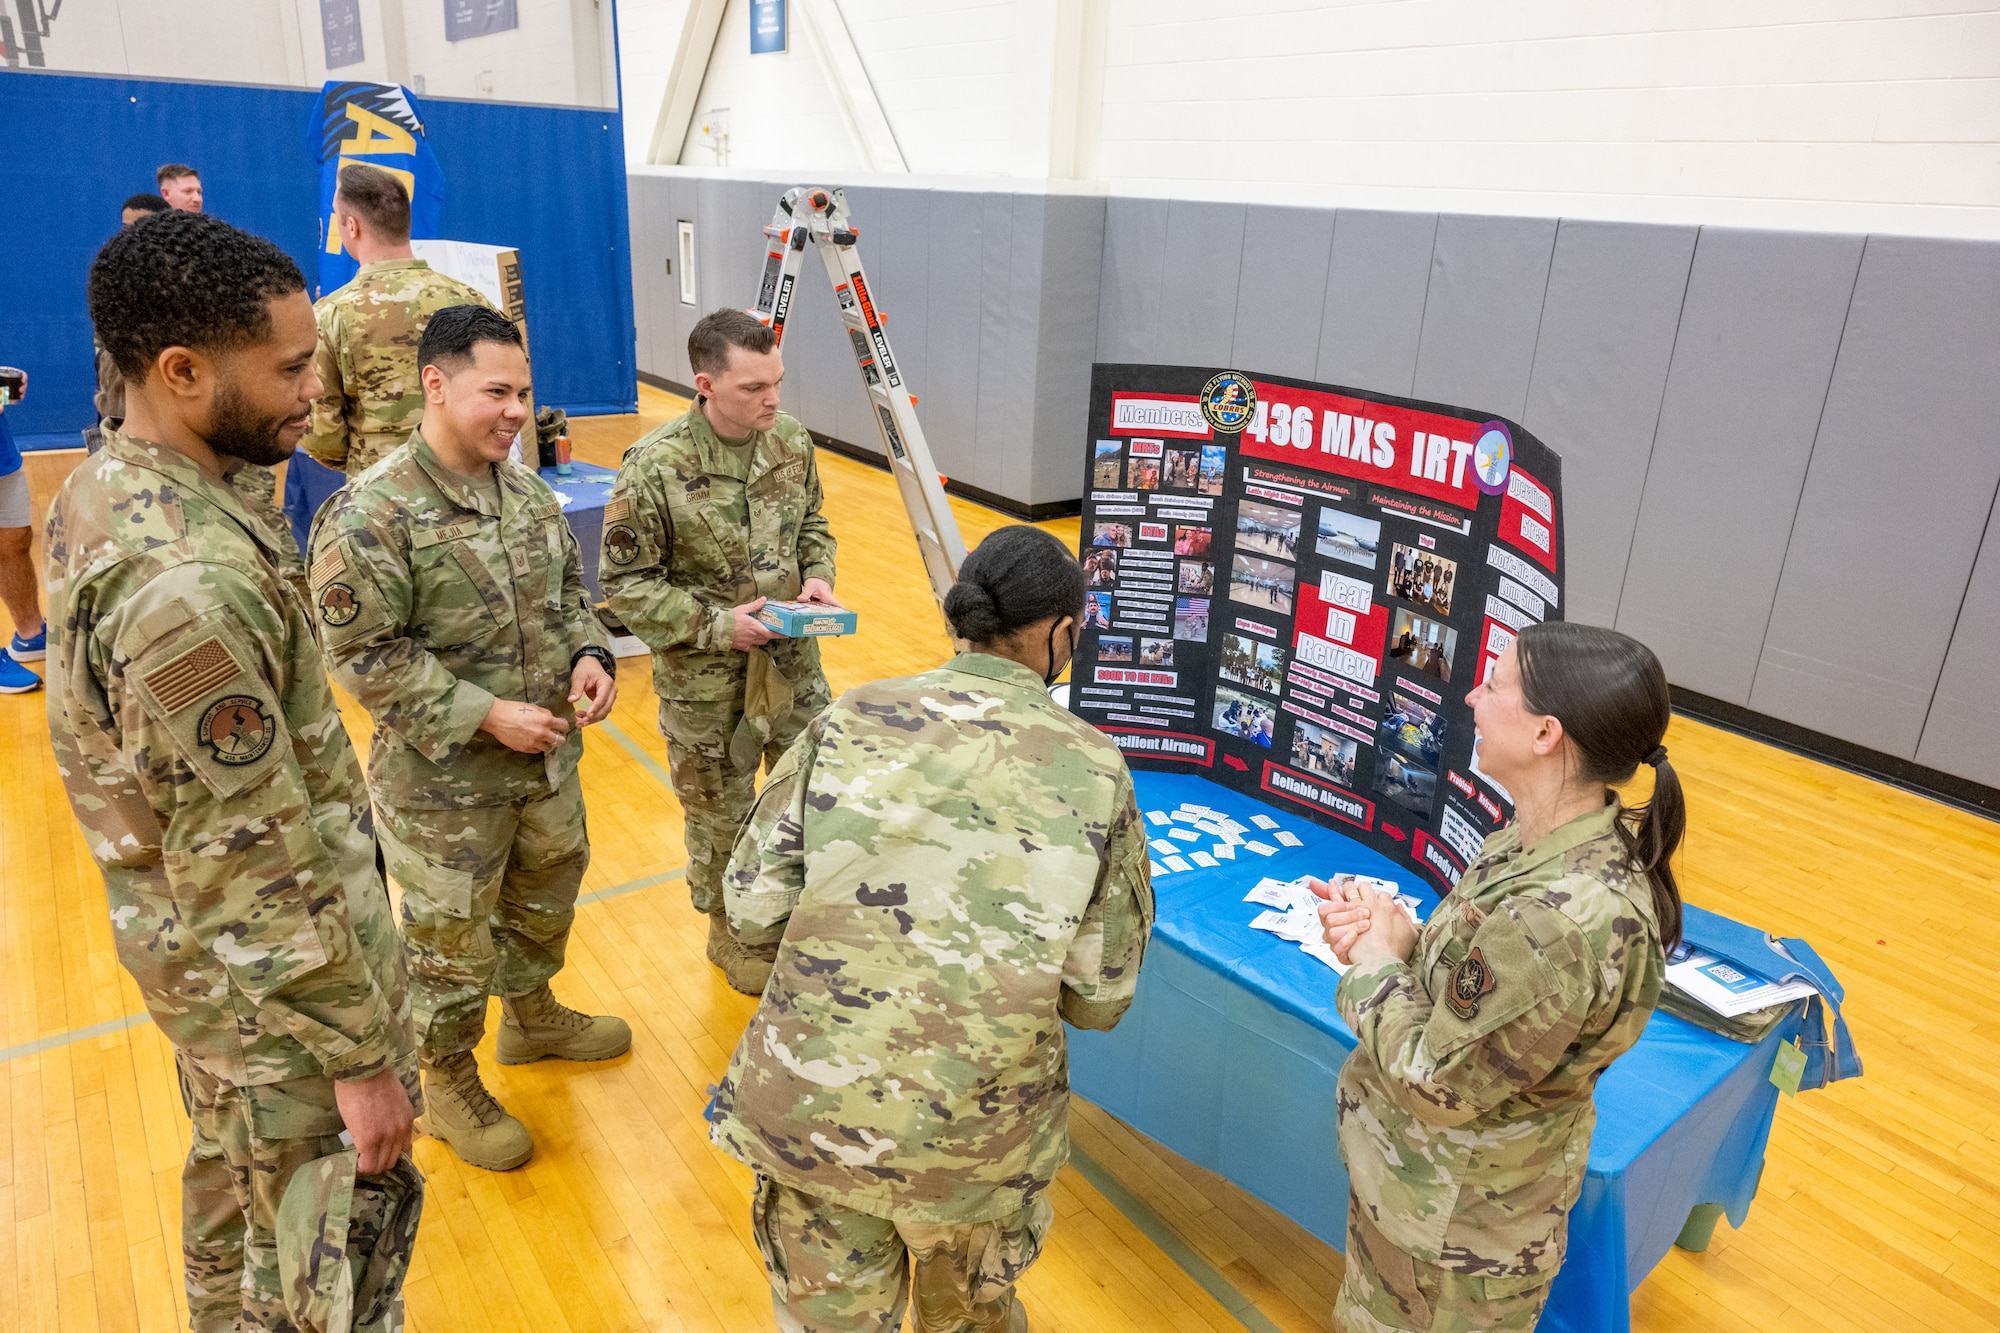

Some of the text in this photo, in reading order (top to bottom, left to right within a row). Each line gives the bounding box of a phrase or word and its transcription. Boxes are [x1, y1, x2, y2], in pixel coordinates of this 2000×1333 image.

[776, 280, 792, 319] LEVELER
[853, 275, 867, 304] Little
[862, 301, 878, 328] Giant
[873, 332, 891, 369] LEVELER
[1204, 382, 1215, 394] TRY
[1213, 373, 1232, 385] FLYING
[1232, 373, 1252, 390] WITHOUT
[1119, 404, 1203, 427] Members:
[1213, 403, 1246, 414] COBRAS
[1132, 441, 1161, 455] MRTs
[1246, 400, 1475, 490] 436 MXS IRT
[686, 490, 710, 502] GRIMM
[1253, 469, 1351, 496] Strengthening the Airmen.
[1264, 490, 1280, 500] Night
[1510, 472, 1552, 520] Operational
[1372, 494, 1461, 526] Maintaining the Mission.
[435, 526, 464, 541] MEJIA
[1141, 525, 1166, 539] RTAs
[1522, 515, 1549, 549] Stress:
[1488, 546, 1558, 604] Work-Life Balance
[1324, 573, 1371, 611] Year
[1500, 578, 1544, 620] Long Shifts
[1329, 611, 1351, 641] In
[1487, 598, 1526, 630] High Ops
[1299, 635, 1374, 682] Review
[1097, 669, 1174, 686] SOON TO BE RTAs
[1288, 674, 1334, 698] Self-Help Library
[1291, 662, 1379, 701] Quarterly Resiliency Topic Emails
[203, 713, 214, 737] SUPPORT
[214, 702, 227, 712] AND
[1283, 702, 1305, 717] Monthly
[1305, 711, 1331, 727] Resiliency
[1332, 721, 1347, 732] Topic
[1332, 705, 1358, 722] Resiliency
[239, 737, 270, 761] MAINTENANCE
[1161, 738, 1206, 757] Airmen
[1272, 771, 1364, 819] Reliable Aircraft
[1449, 772, 1473, 795] Problem
[1426, 843, 1452, 879] Ready
